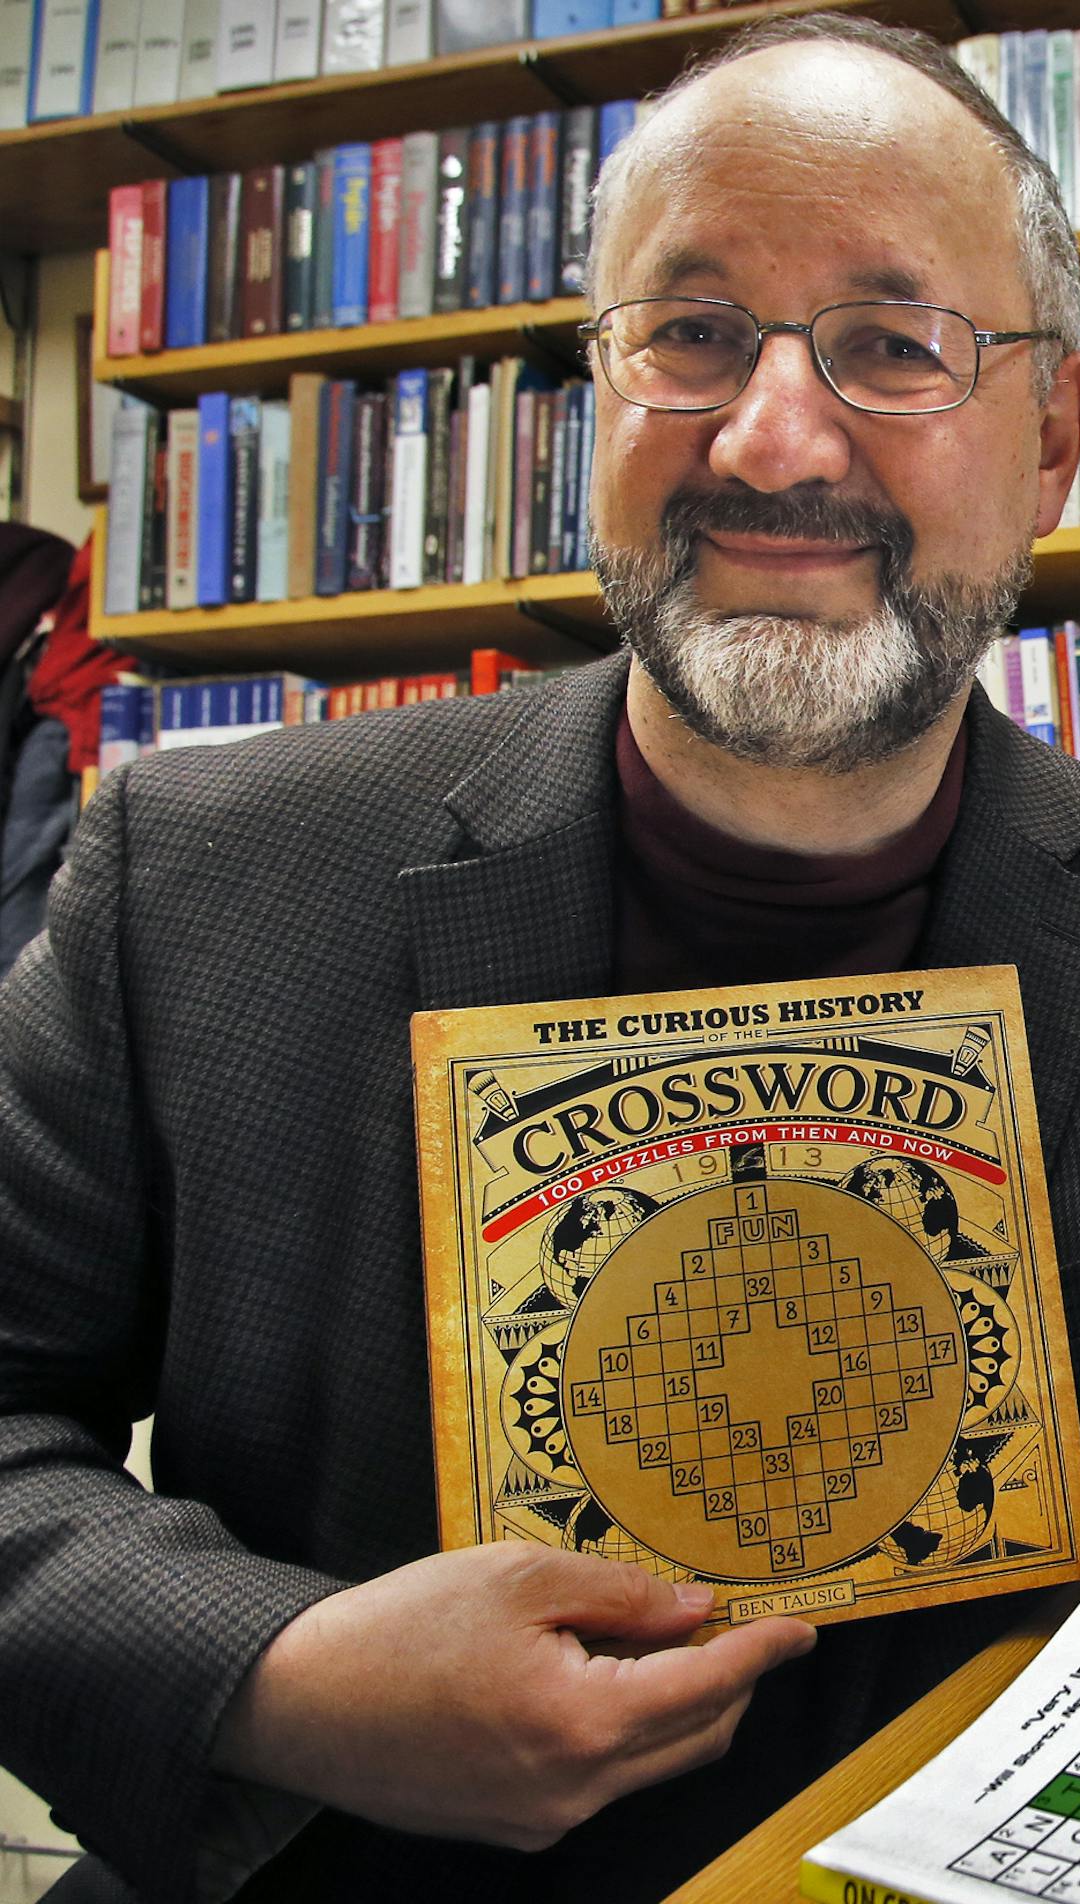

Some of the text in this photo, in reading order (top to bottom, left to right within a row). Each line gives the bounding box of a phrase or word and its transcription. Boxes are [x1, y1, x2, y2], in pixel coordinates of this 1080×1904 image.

[533, 991, 925, 1044] THE CURIOUS HISTORY
[708, 1029, 764, 1042] OF THE
[512, 1062, 967, 1174] CROSSWORD
[538, 1128, 955, 1206] 100 PUZZLES FROM THEN AND NOW
[748, 1192, 757, 1210] 1
[714, 1214, 796, 1246] FUN
[808, 1241, 820, 1259] 3
[691, 1254, 706, 1274] 2
[748, 1275, 772, 1296] 32
[871, 1292, 883, 1310] 9
[897, 1315, 919, 1333] 13
[810, 1325, 837, 1346] 12
[696, 1343, 716, 1361] 11
[929, 1340, 953, 1360] 17
[604, 1353, 628, 1373] 10
[844, 1353, 868, 1371] 16
[668, 1376, 690, 1397] 15
[904, 1375, 928, 1395] 21
[575, 1387, 600, 1408] 14
[818, 1386, 842, 1406] 20
[701, 1401, 724, 1422] 19
[879, 1408, 903, 1429] 25
[610, 1413, 632, 1436] 18
[791, 1419, 816, 1440] 24
[732, 1428, 758, 1449] 23
[642, 1441, 669, 1461] 22
[853, 1441, 877, 1461] 27
[765, 1452, 790, 1474] 33
[675, 1466, 701, 1487] 26
[826, 1473, 852, 1494] 29
[709, 1492, 735, 1513] 28
[741, 1516, 766, 1538] 30
[802, 1507, 826, 1527] 31
[774, 1544, 799, 1564] 34
[737, 1586, 846, 1618] BEN TAUSIG
[1014, 1722, 1065, 1767] Shortz,
